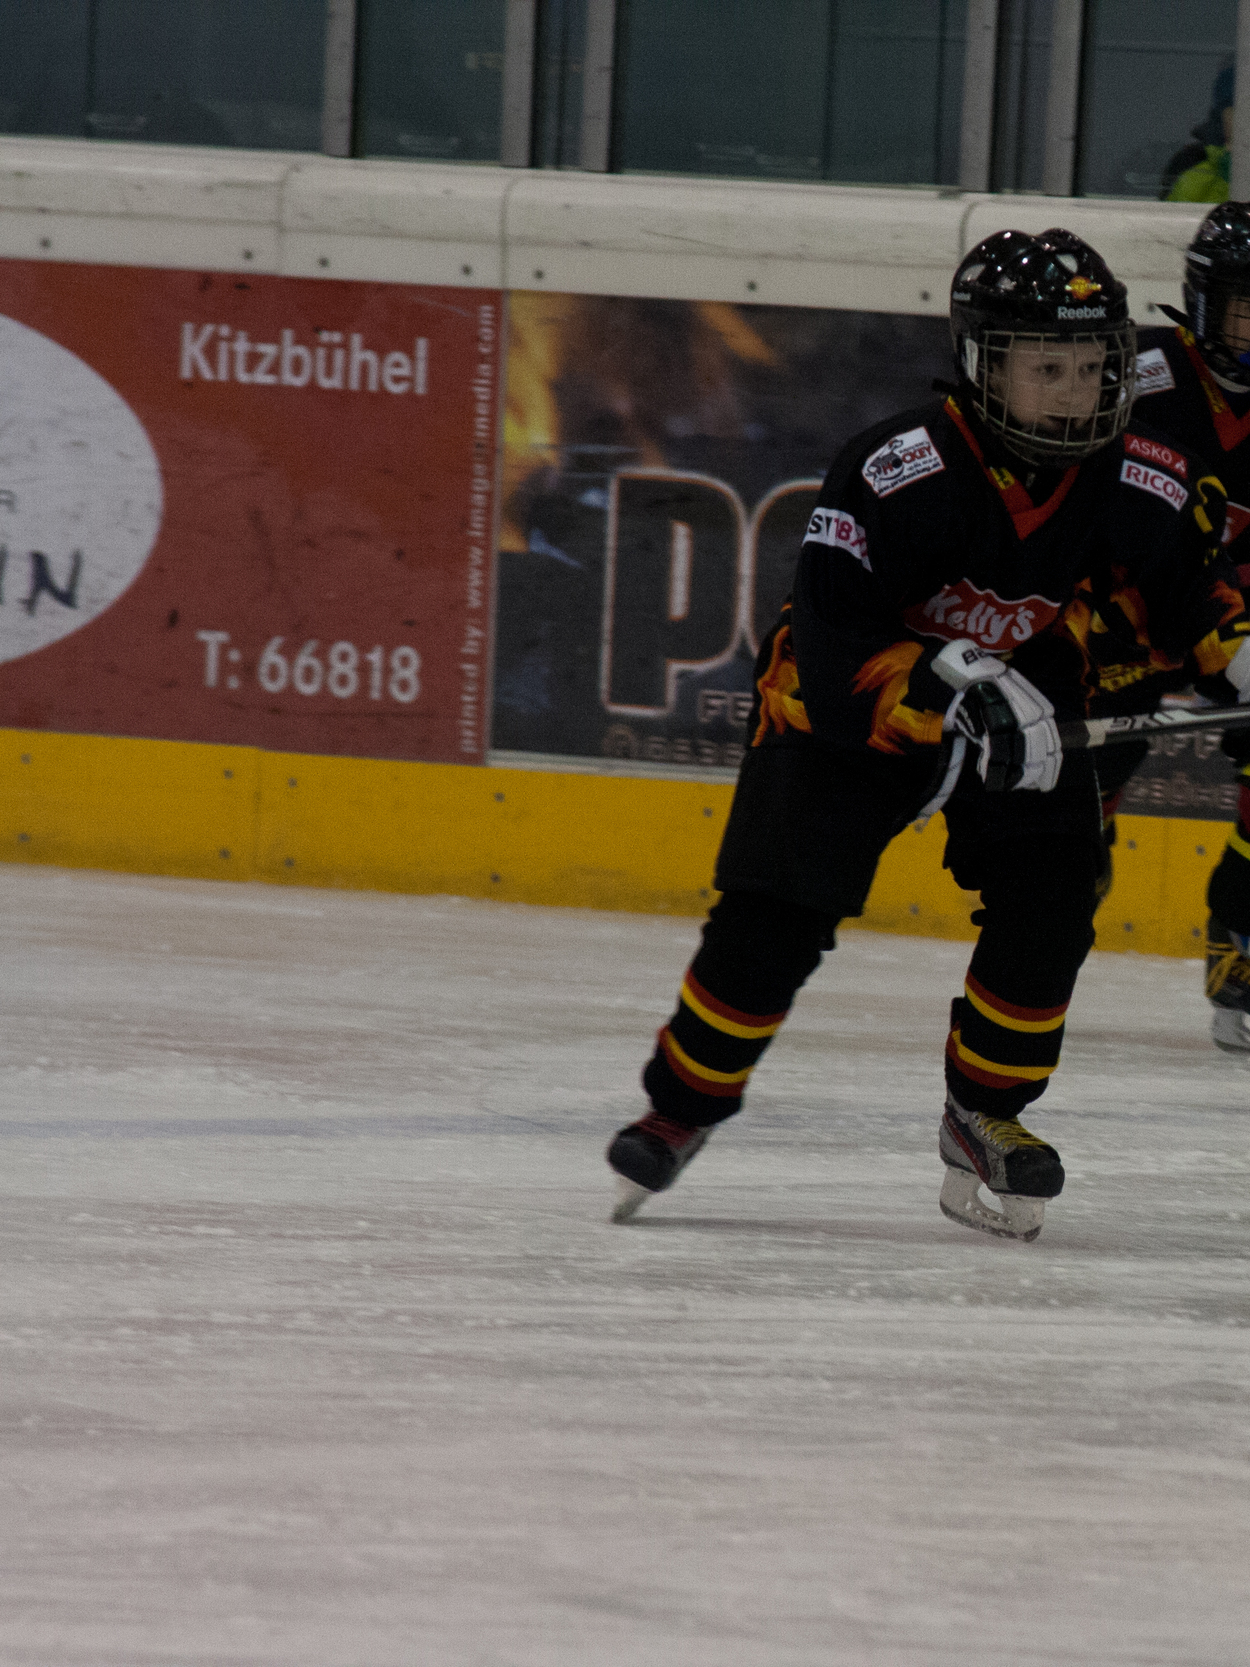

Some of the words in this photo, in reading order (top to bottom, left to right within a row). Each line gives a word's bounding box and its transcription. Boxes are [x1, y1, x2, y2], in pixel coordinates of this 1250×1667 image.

[1057, 305, 1108, 320] Reebok
[179, 323, 430, 395] Kitzbühel
[1129, 438, 1173, 464] ASKO
[1126, 465, 1185, 505] RICOH
[922, 584, 1036, 645] Kelly's
[197, 630, 240, 689] T:
[258, 637, 421, 703] 66818
[459, 664, 478, 753] printed
